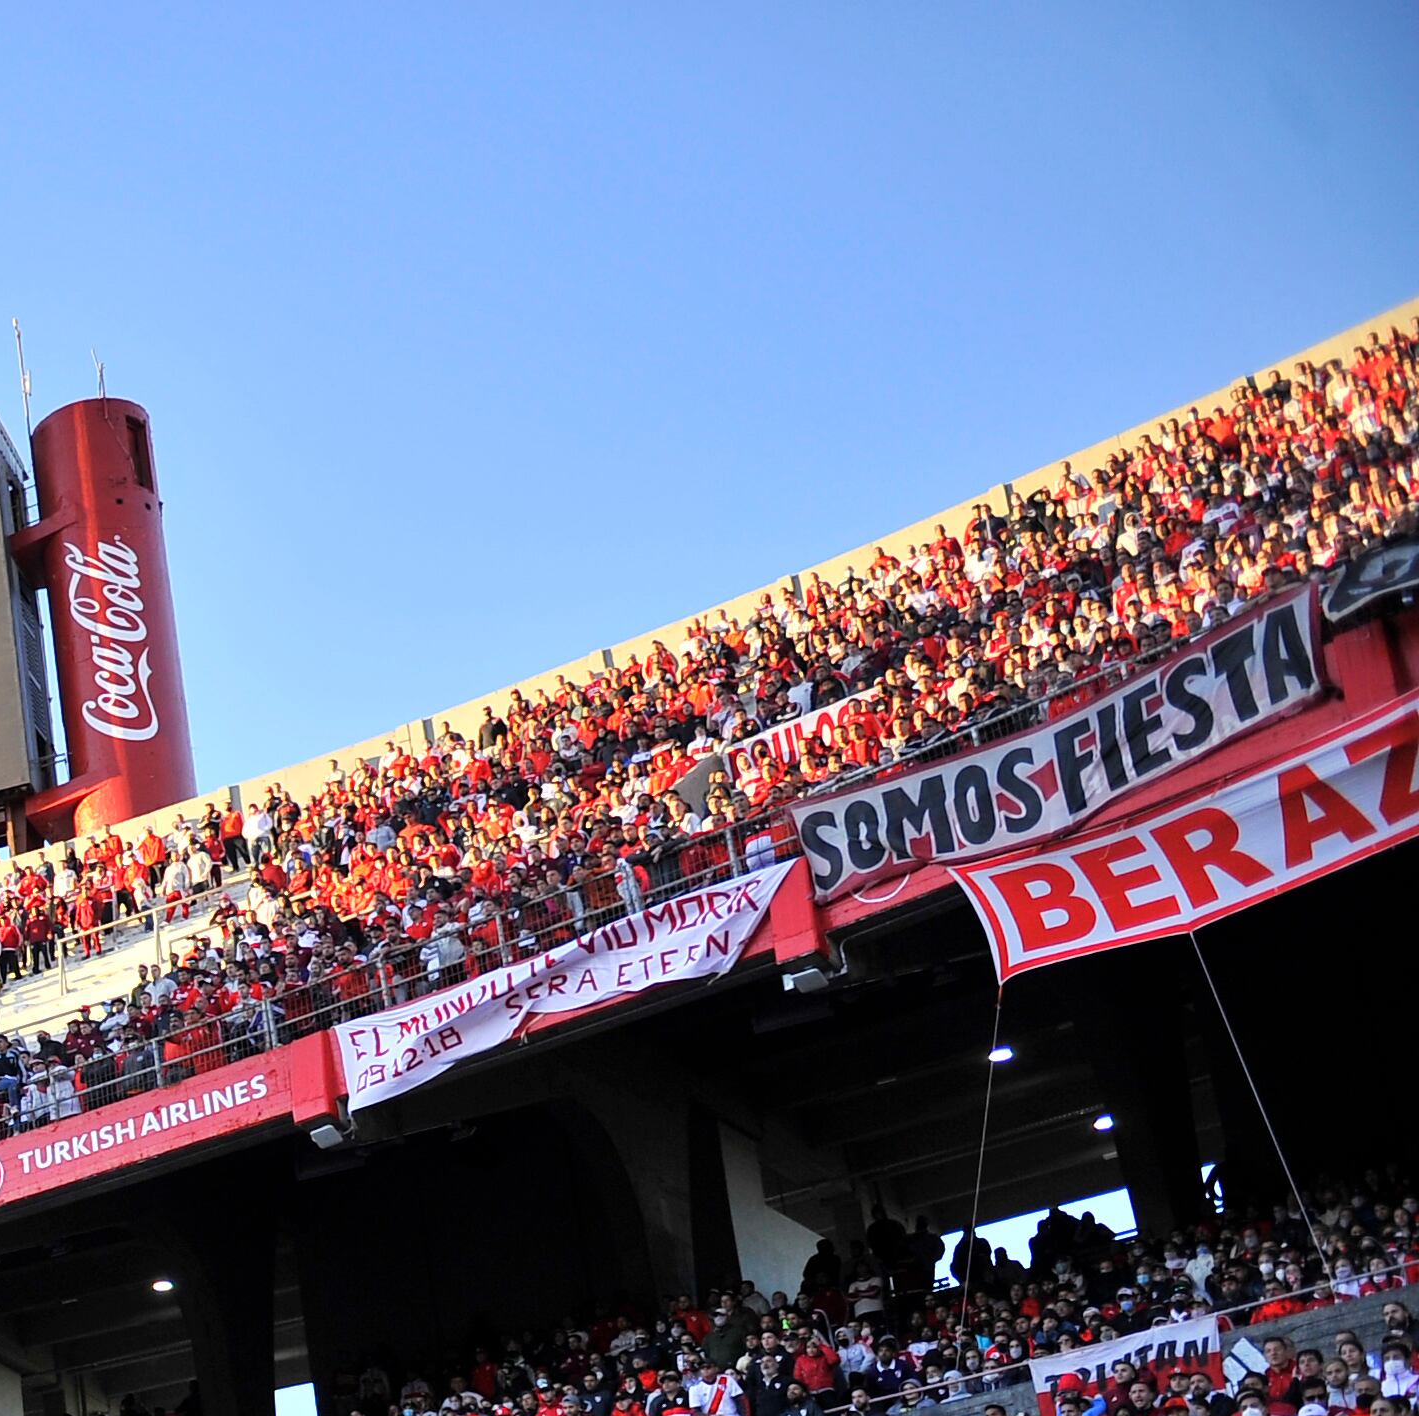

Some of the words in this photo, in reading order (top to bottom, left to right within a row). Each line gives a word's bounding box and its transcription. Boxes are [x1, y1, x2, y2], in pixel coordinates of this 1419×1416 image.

[65, 533, 161, 742] Coca-Cola
[799, 747, 1051, 890] SOMOS
[1054, 606, 1315, 815] FIESTA
[350, 1029, 391, 1062] EL
[18, 1117, 138, 1176] TURKISH
[141, 1073, 268, 1136] AIRLINES
